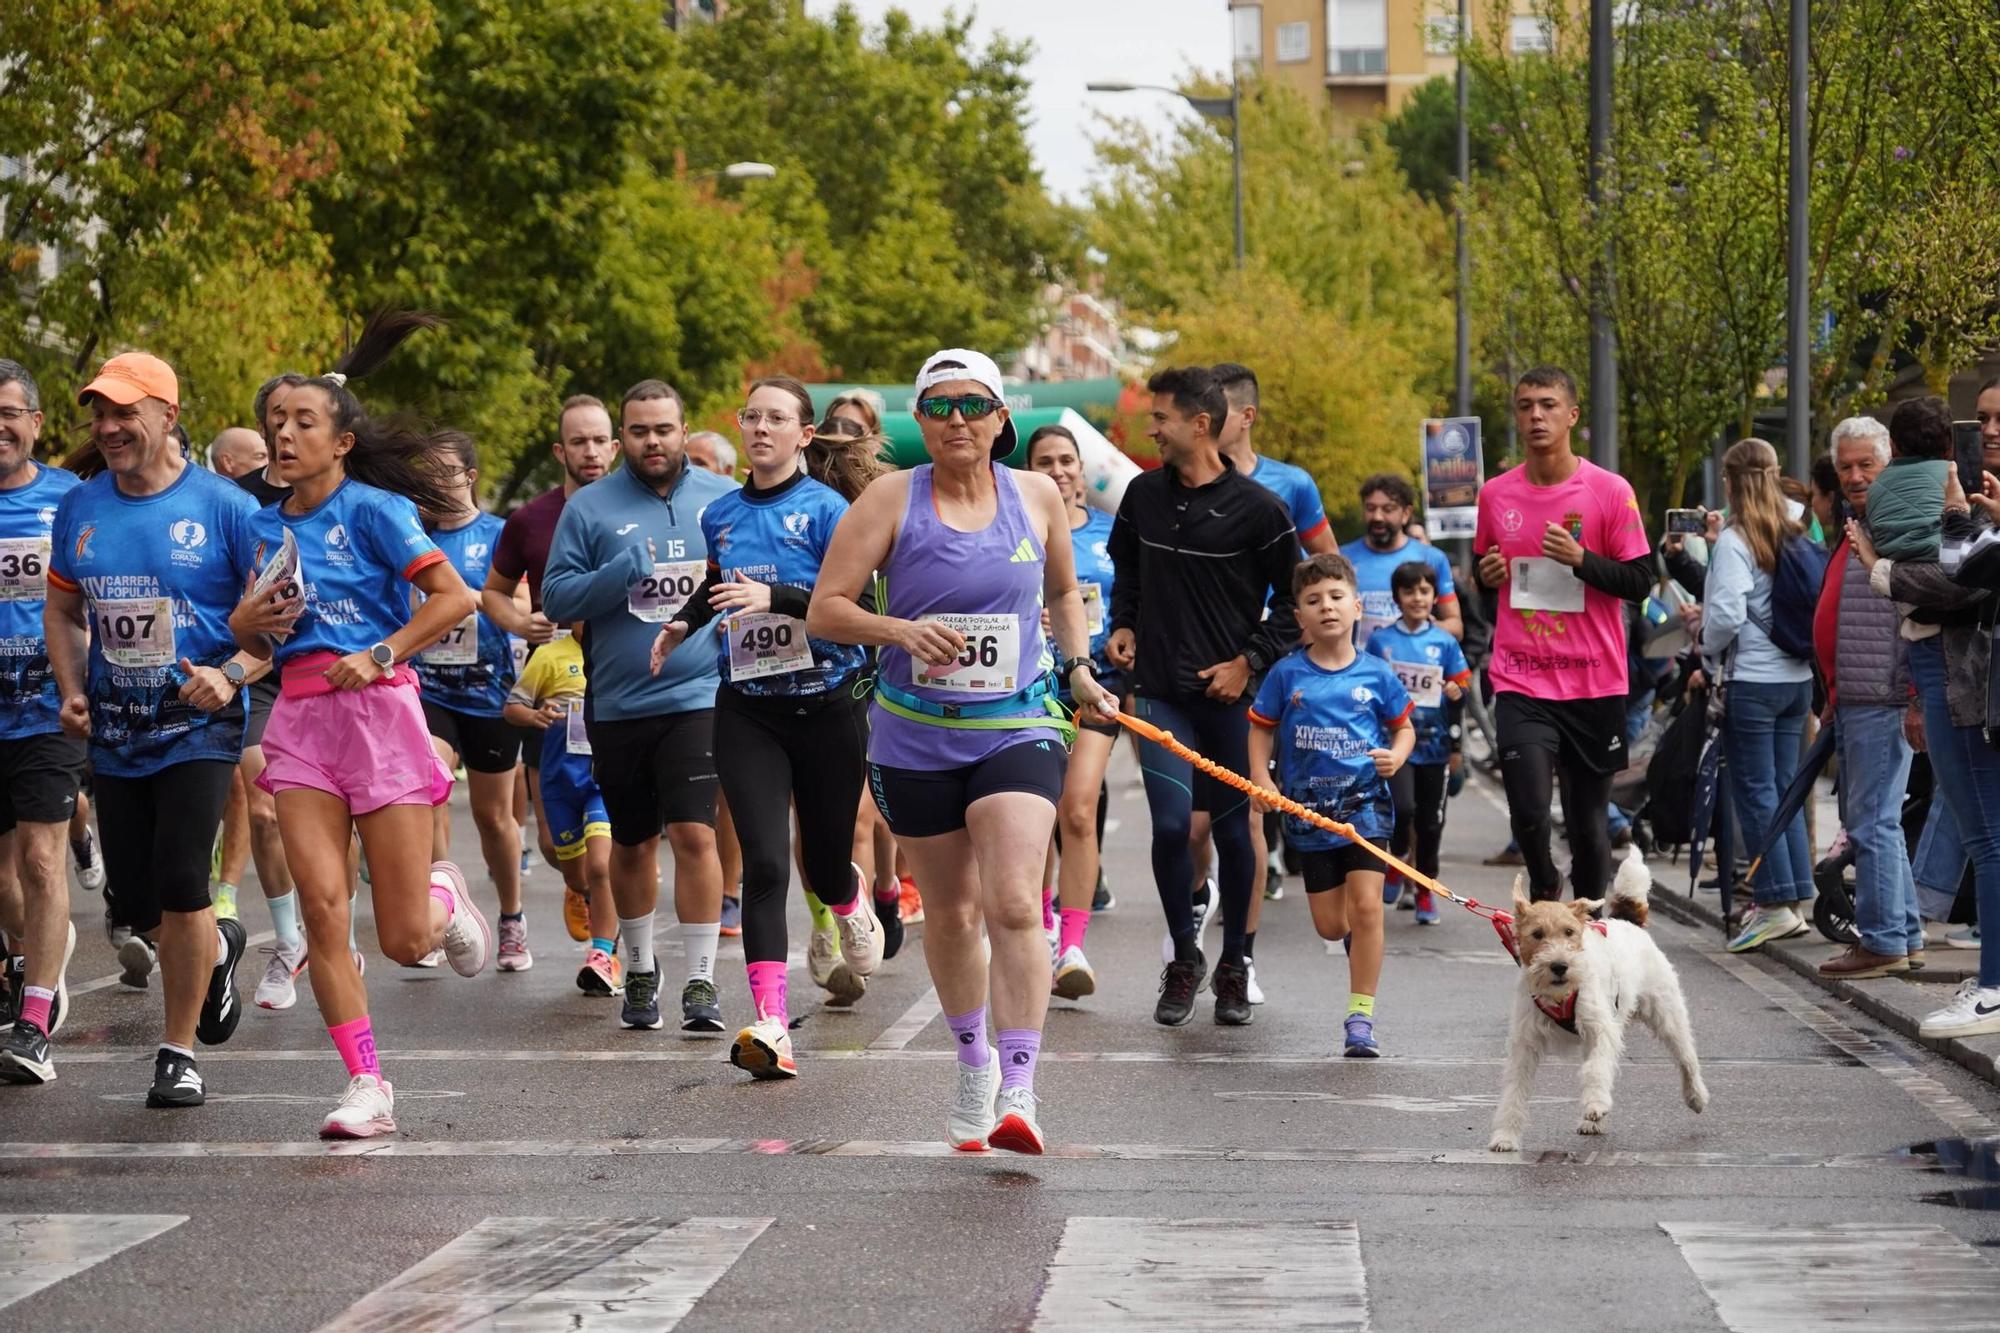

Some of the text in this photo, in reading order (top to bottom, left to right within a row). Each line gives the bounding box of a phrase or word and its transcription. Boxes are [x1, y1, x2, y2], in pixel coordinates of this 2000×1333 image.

[666, 540, 686, 559] 15
[106, 576, 159, 586] CARRERA
[641, 576, 694, 598] 200
[107, 587, 160, 598] POPULAR
[315, 597, 360, 615] CIVIL
[101, 614, 156, 640] 107
[936, 615, 999, 624] CARRERA POPULAR
[983, 624, 1010, 632] ZAMORA
[740, 624, 792, 652] 490
[1295, 725, 1315, 741] XIV
[1295, 740, 1341, 751] GUARDIA
